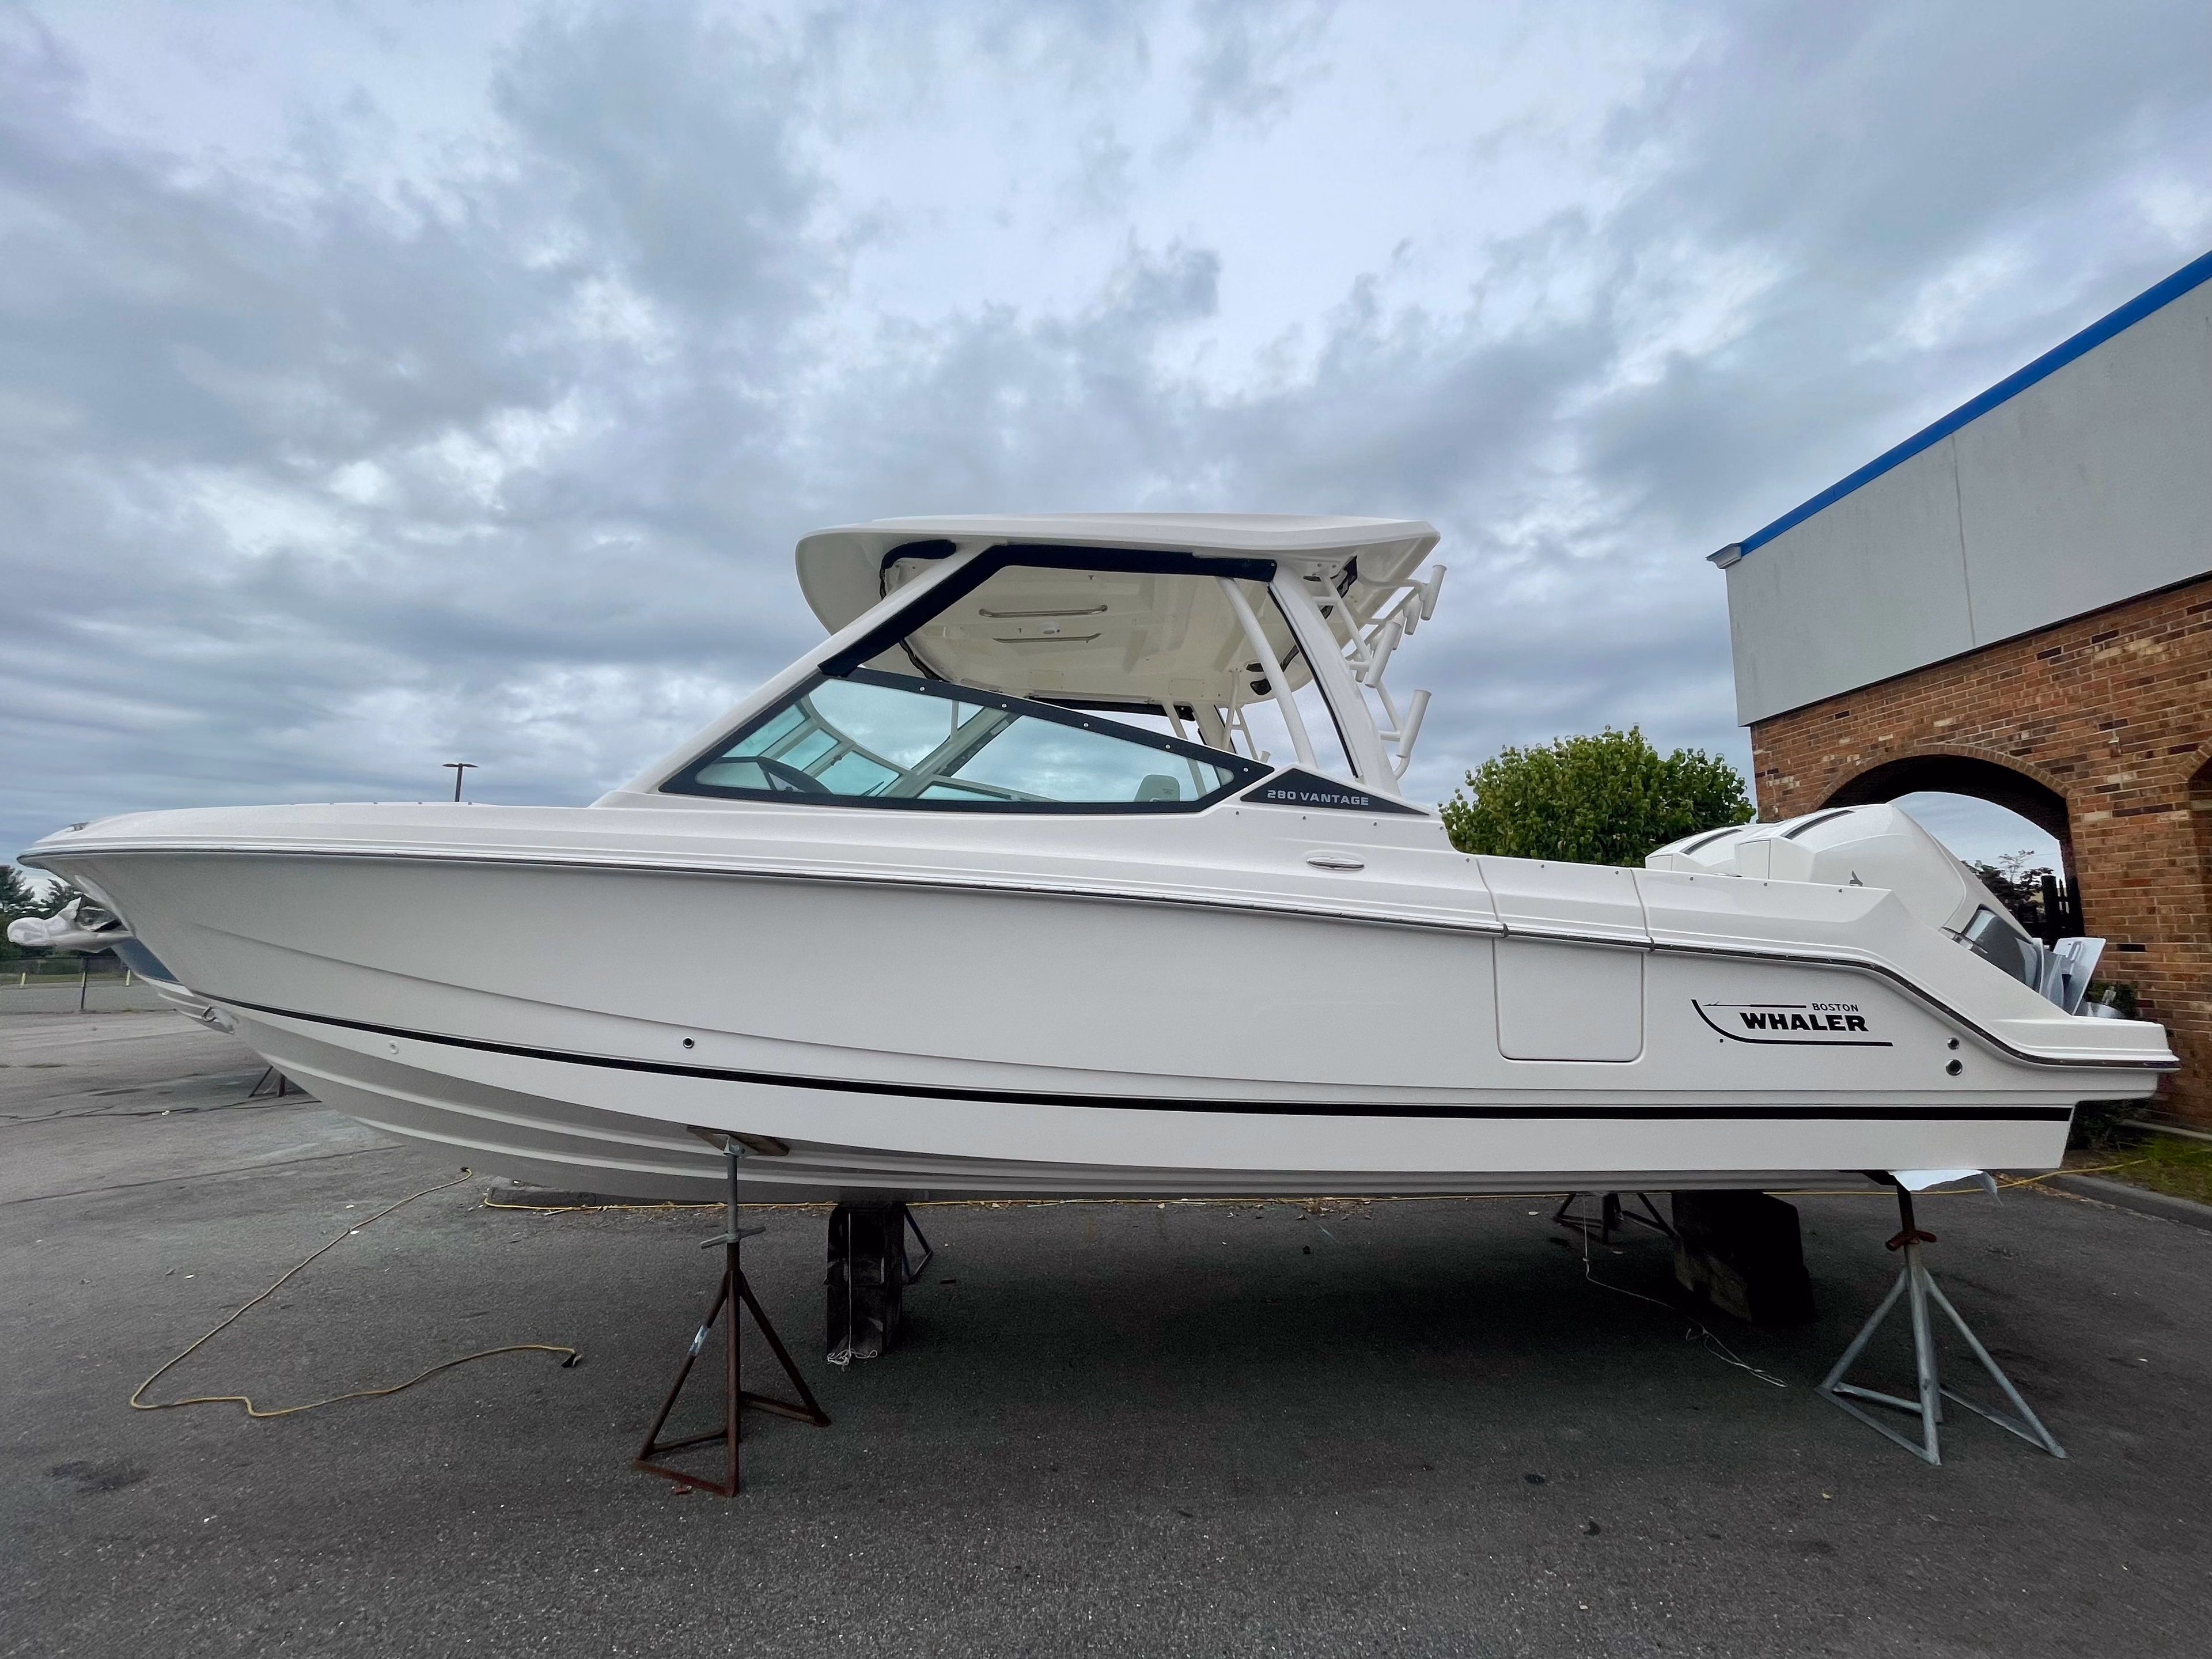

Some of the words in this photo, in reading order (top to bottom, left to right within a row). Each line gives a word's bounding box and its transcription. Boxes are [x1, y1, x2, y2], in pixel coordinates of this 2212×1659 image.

[1267, 790, 1296, 800] 280
[1300, 792, 1369, 805] VANTAGE
[1813, 1003, 1859, 1012] BOSTON
[1740, 1012, 1869, 1032] WHALER
